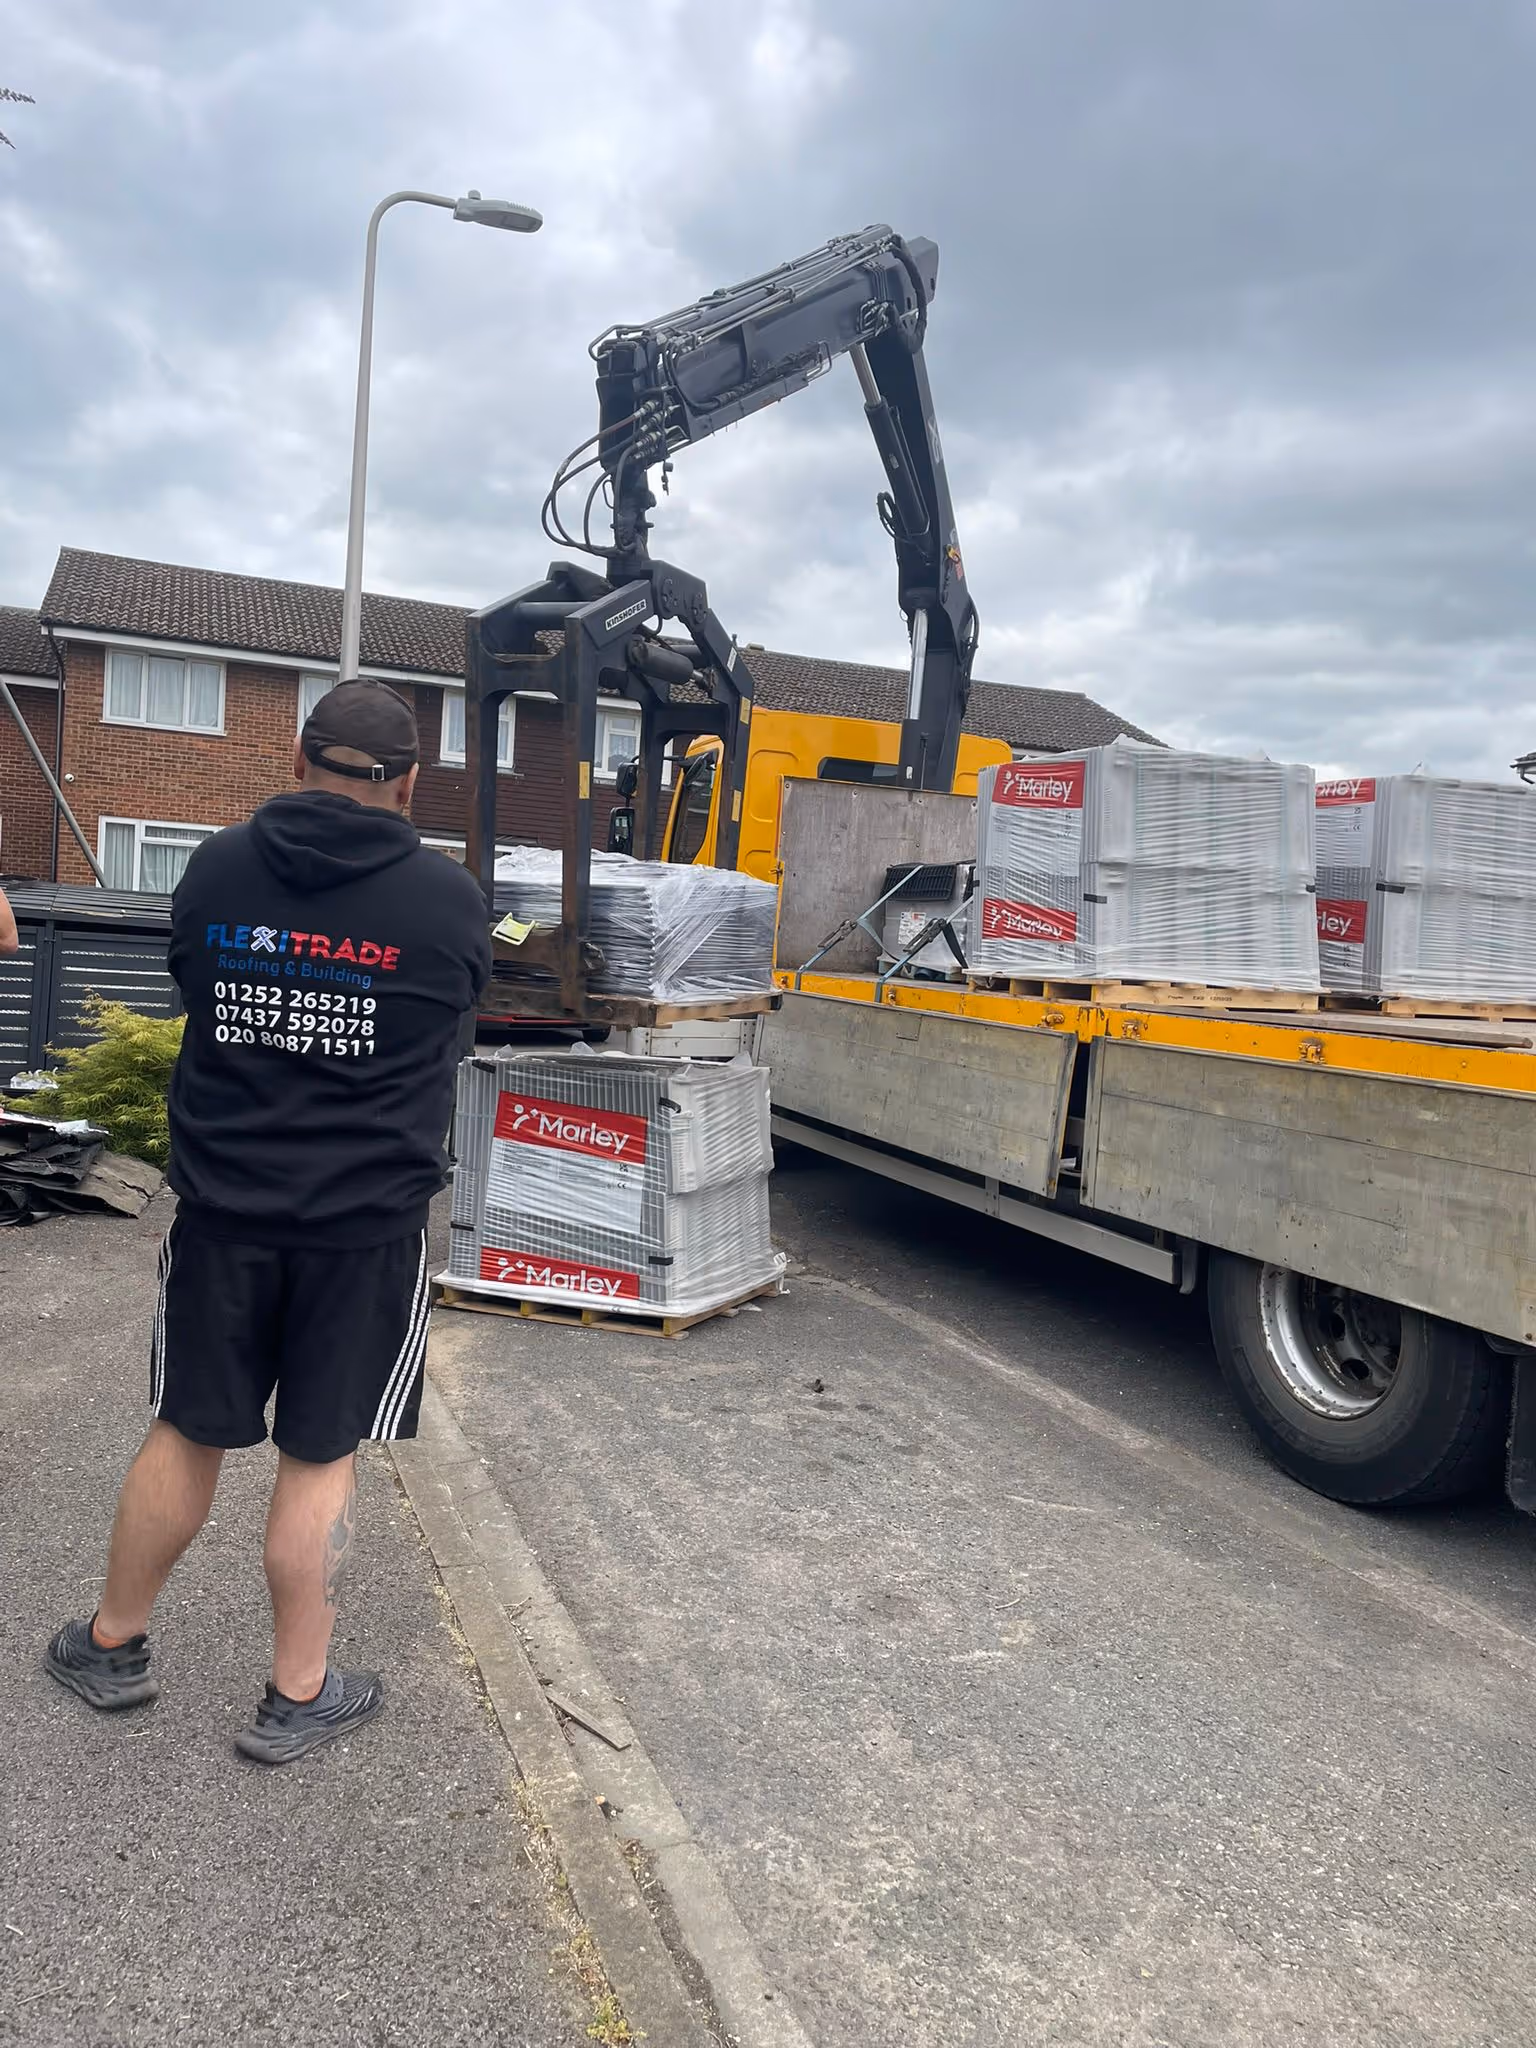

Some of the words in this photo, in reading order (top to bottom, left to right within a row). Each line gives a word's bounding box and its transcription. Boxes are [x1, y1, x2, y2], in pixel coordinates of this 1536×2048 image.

[606, 601, 646, 629] KINSHOFER
[1018, 776, 1073, 803] Marley
[1315, 779, 1361, 799] arley
[218, 953, 280, 977] Roofing
[284, 961, 296, 976] &
[301, 962, 372, 990] Building
[214, 980, 283, 1005] 01252
[288, 989, 377, 1015] 265219
[215, 1003, 282, 1028] 07437
[287, 1012, 375, 1036] 592078
[215, 1024, 256, 1044] 020
[260, 1031, 314, 1054] 8087
[321, 1037, 375, 1056] 1511
[538, 1113, 630, 1155] Marley
[525, 1264, 622, 1297] Marley
